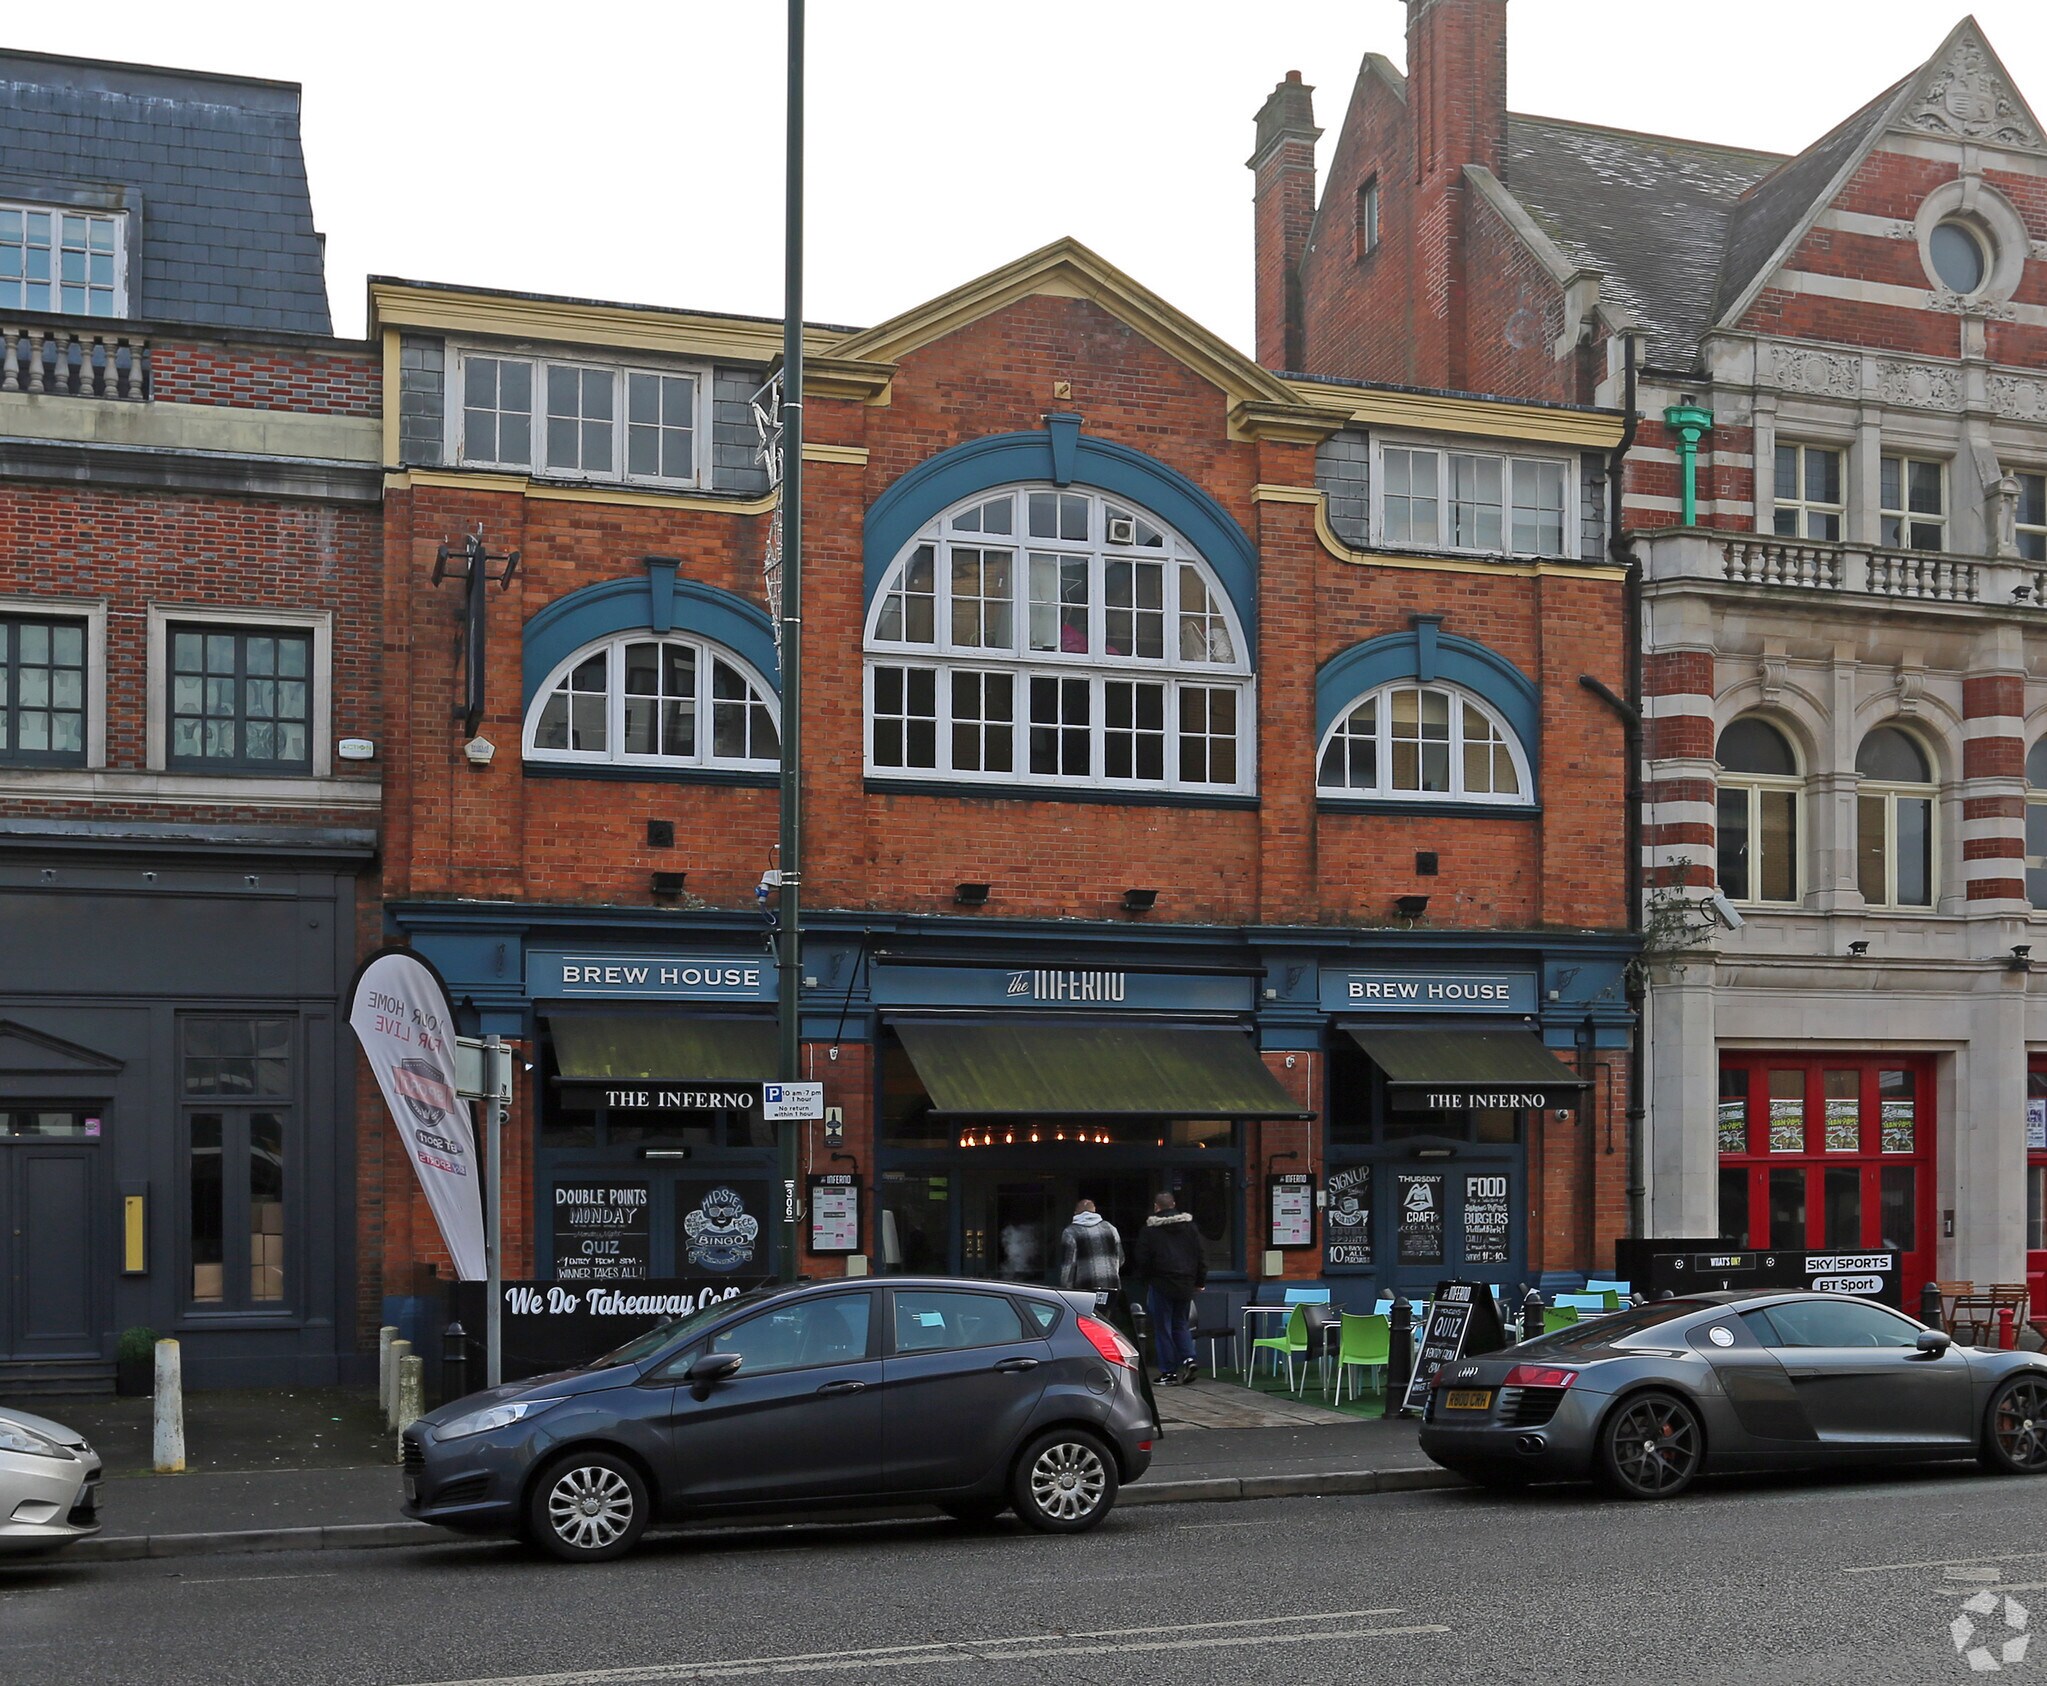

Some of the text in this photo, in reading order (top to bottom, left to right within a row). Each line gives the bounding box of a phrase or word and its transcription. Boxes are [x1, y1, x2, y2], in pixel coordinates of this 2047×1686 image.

[562, 965, 760, 986] BREW HOUSE
[1007, 970, 1125, 1001] the INFERNO
[1348, 982, 1509, 999] BREW HOUSE
[606, 1091, 753, 1109] THE INFERNO
[769, 1088, 779, 1100] P
[1427, 1094, 1545, 1108] THE INFERNO
[827, 1175, 851, 1184] INFERNO
[1285, 1175, 1307, 1183] INFERNO
[1398, 1175, 1441, 1183] THURSDAY
[1467, 1177, 1506, 1197] FOOD
[556, 1188, 647, 1205] DOUBLE POINTS
[702, 1189, 743, 1217] HIPSTER
[569, 1208, 638, 1224] MONDAY
[1406, 1212, 1435, 1223] CRAFT
[1464, 1213, 1508, 1224] BURGERS
[581, 1240, 620, 1255] QUIZ
[699, 1236, 744, 1245] BINGO
[1710, 1257, 1730, 1266] WHAT'S
[1807, 1258, 1888, 1270] SKY SPORTS
[559, 1268, 591, 1278] WINNER
[593, 1267, 618, 1278] TAKES
[1820, 1278, 1874, 1292] BT Sport
[1448, 1286, 1471, 1301] INFERNO
[505, 1286, 543, 1315] We
[547, 1286, 581, 1315] Do
[585, 1287, 695, 1318] Takeaway
[1434, 1316, 1463, 1338] QUIZ
